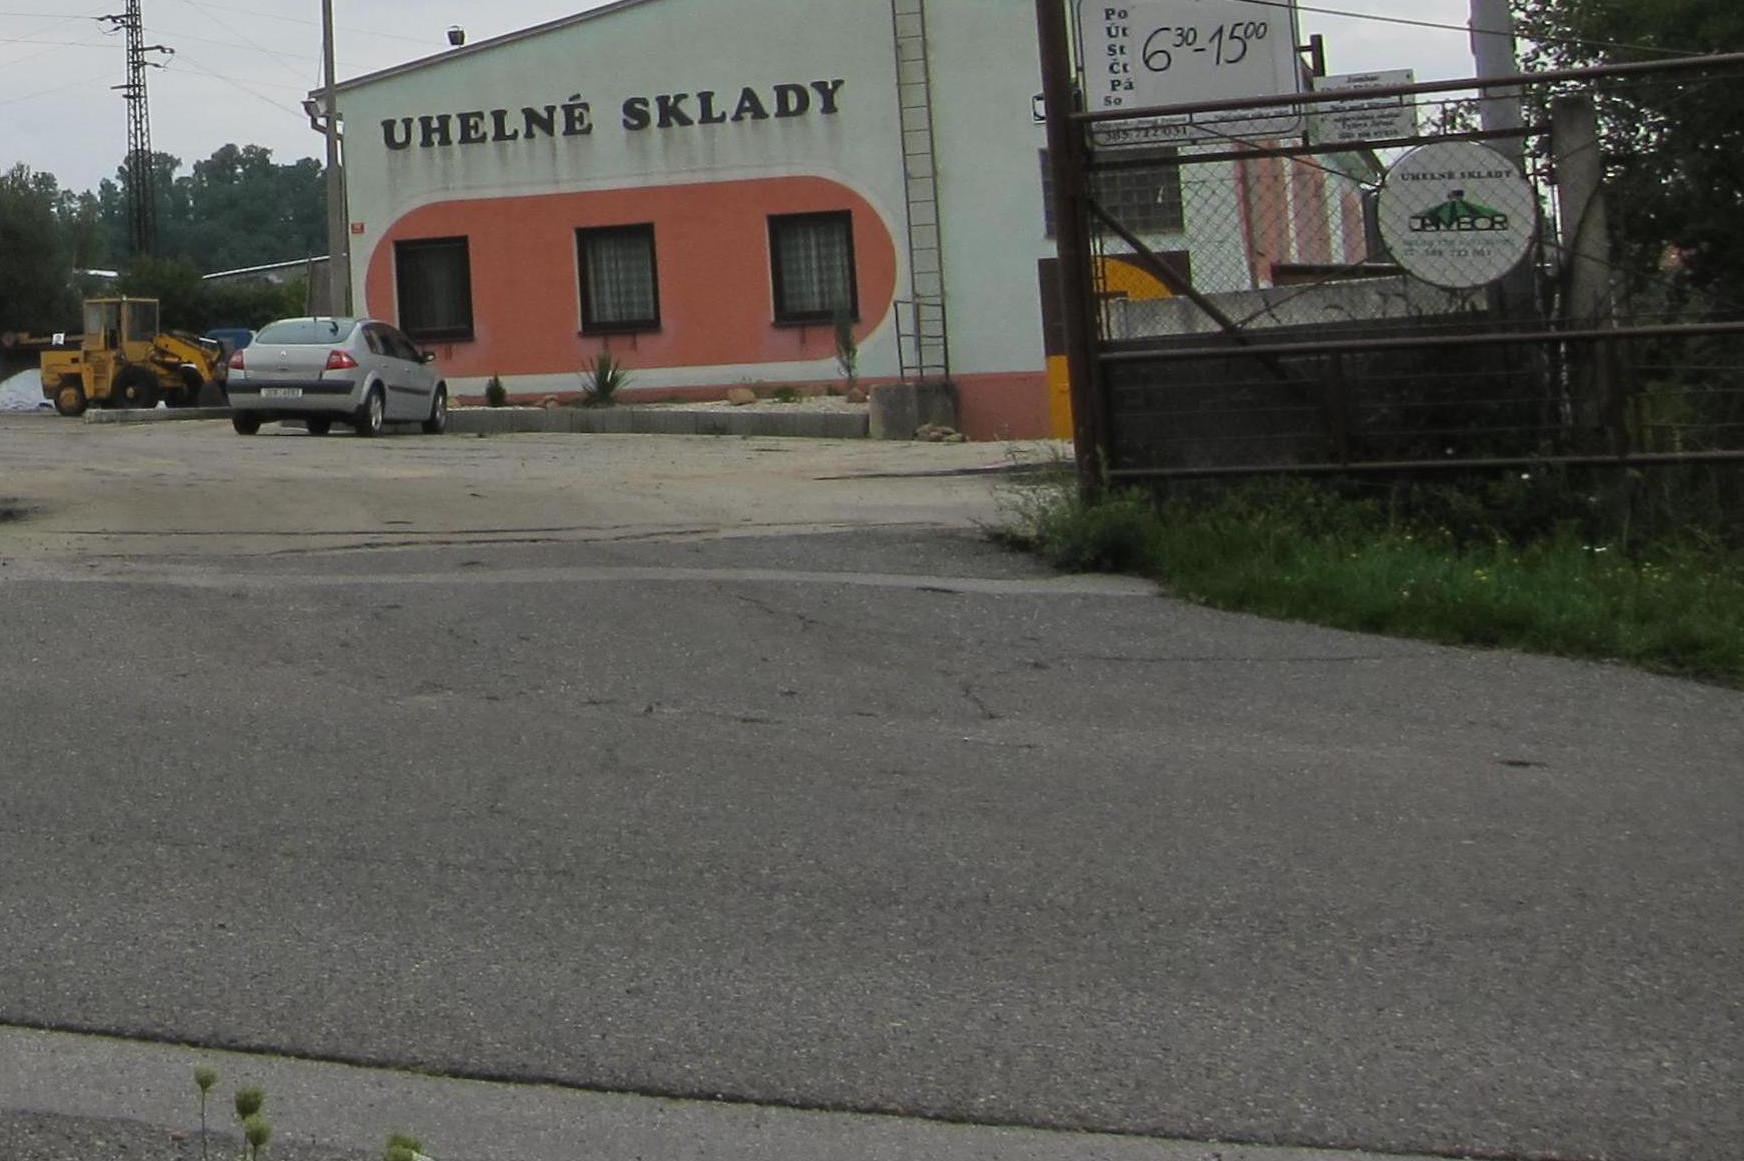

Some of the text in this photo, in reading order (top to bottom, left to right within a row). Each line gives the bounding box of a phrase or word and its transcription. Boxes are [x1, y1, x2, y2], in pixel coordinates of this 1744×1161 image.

[1105, 7, 1129, 21] Po
[1107, 43, 1127, 57] St
[1111, 78, 1135, 92] Pá
[1104, 95, 1123, 107] So
[381, 79, 845, 151] UHELNÉ SKLADY
